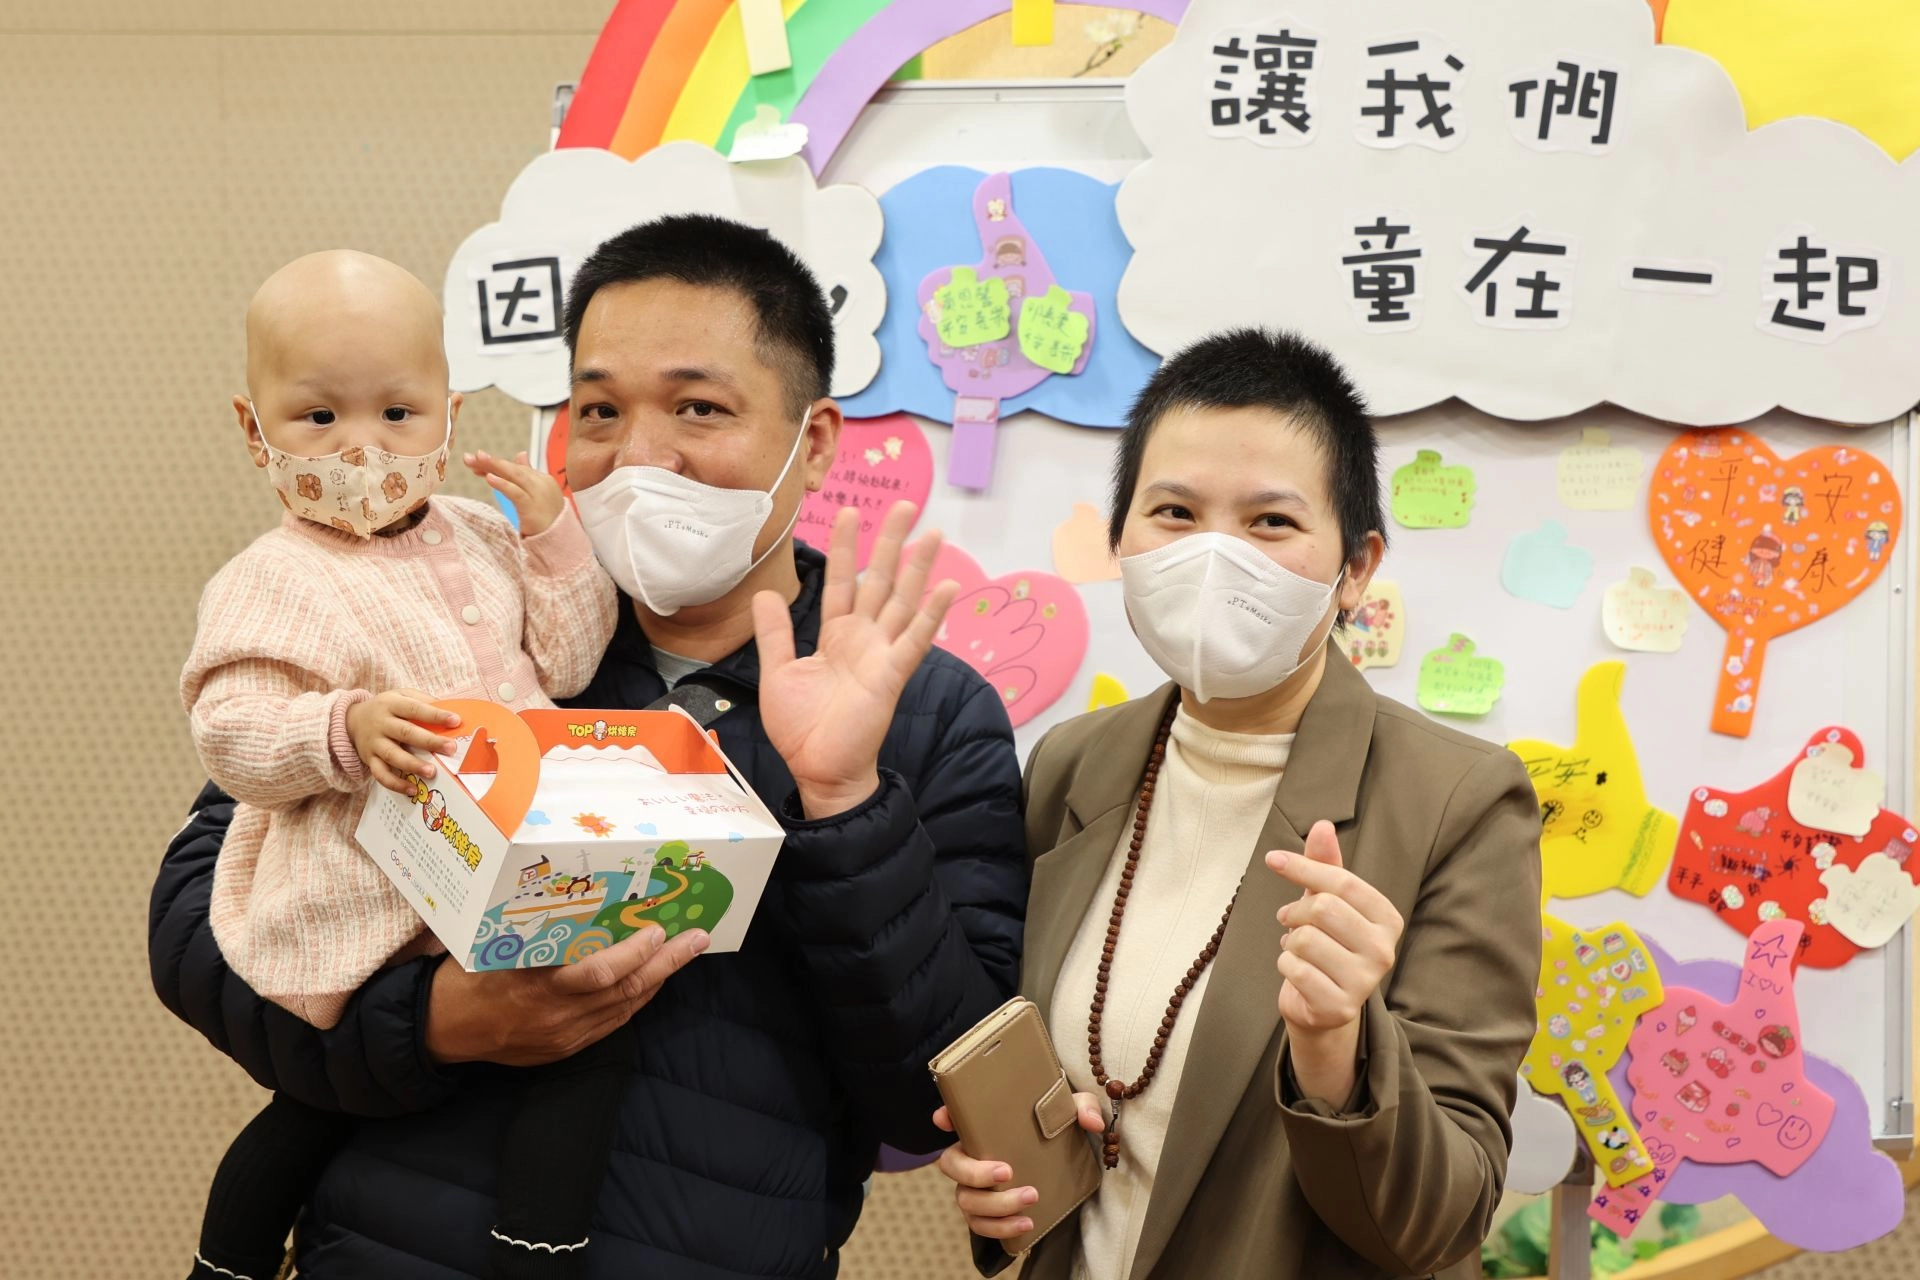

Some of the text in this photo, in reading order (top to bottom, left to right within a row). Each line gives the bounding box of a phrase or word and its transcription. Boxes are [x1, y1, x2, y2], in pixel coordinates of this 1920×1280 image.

[1210, 28, 1619, 145] 讓我們
[476, 256, 562, 346] 因
[1341, 216, 1880, 333] 童在一起
[1709, 458, 1853, 525] 平安
[1686, 533, 1838, 594] 健康
[567, 723, 637, 737] TOP 烘焙房
[390, 849, 412, 882] Google
[440, 814, 483, 872] 烘焙房
